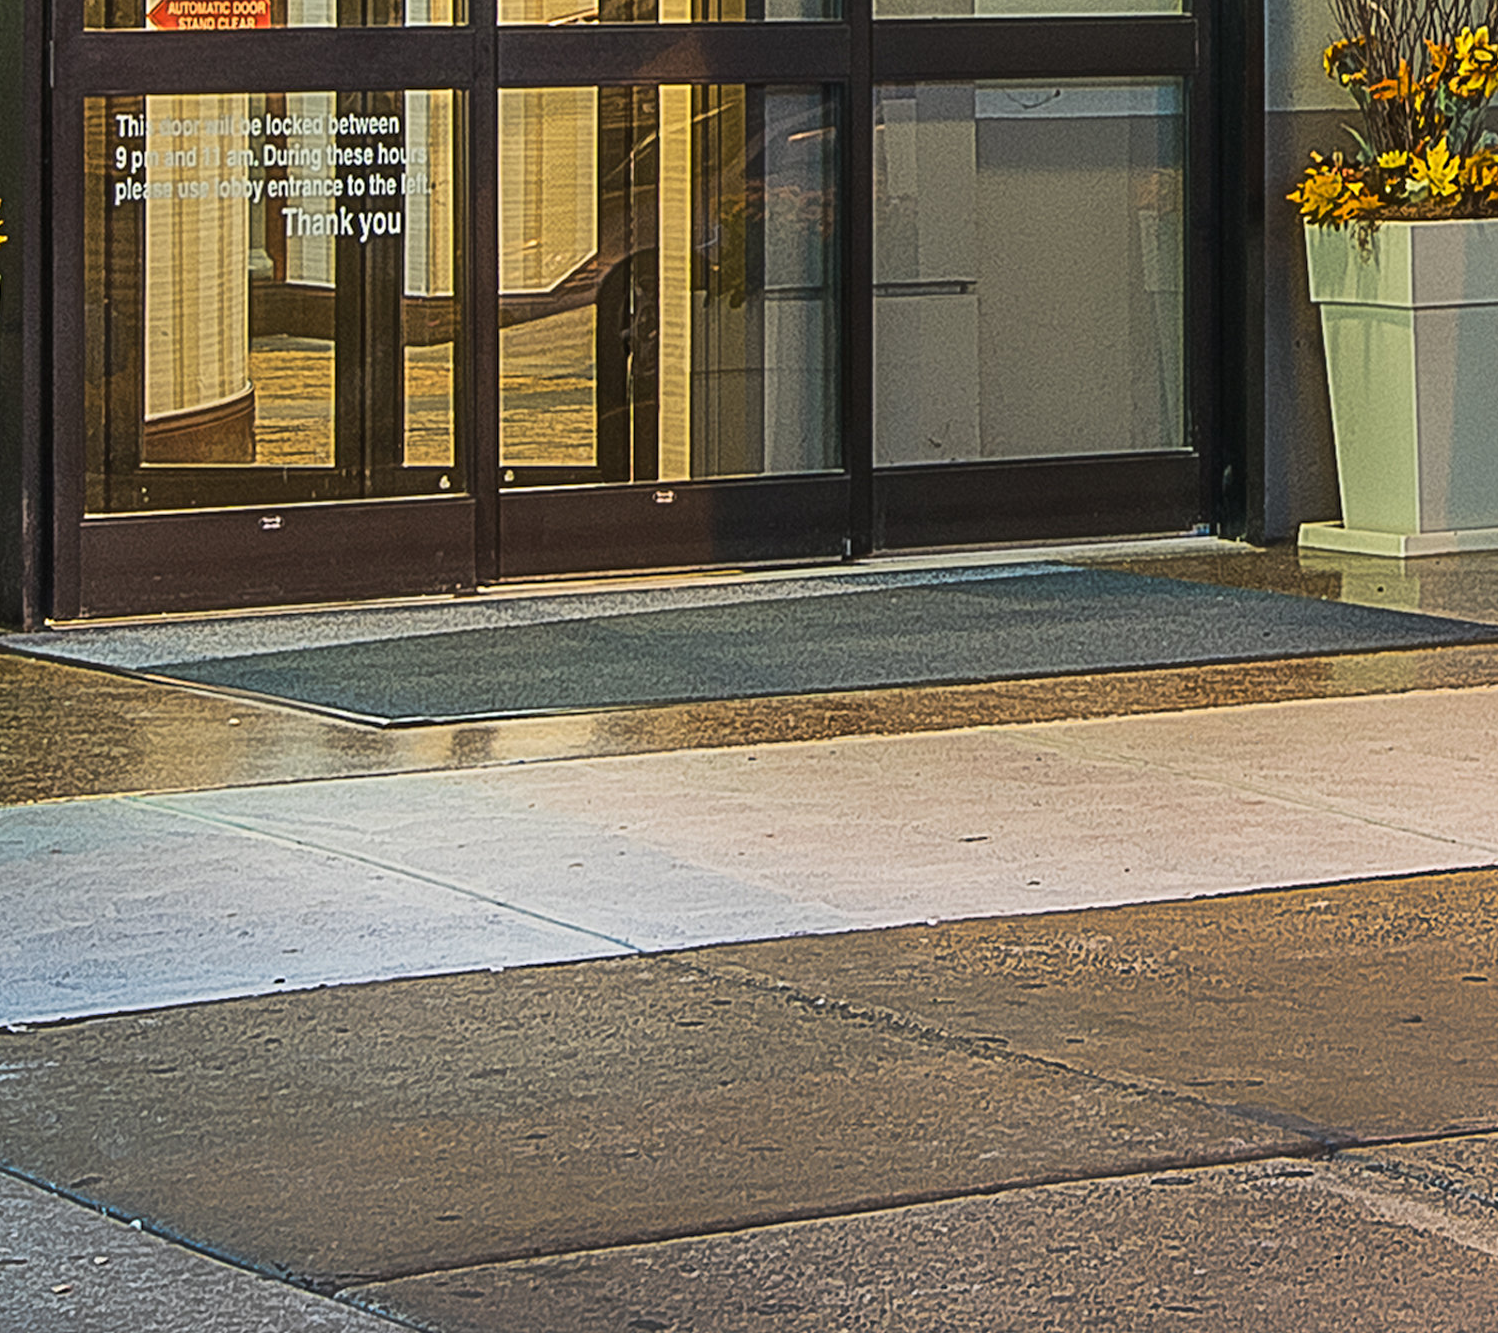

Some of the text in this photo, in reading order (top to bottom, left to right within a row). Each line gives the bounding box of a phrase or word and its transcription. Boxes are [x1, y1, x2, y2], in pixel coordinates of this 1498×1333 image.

[168, 0, 267, 15] AUTOMATIC DOOR
[178, 16, 256, 30] STAND CLEAR
[115, 113, 400, 138] This door will be locked between
[115, 142, 427, 174] 9 pm and 11 am. During these hours
[114, 172, 431, 206] please use lobby entrance to the left.
[281, 206, 401, 243] Thank you
